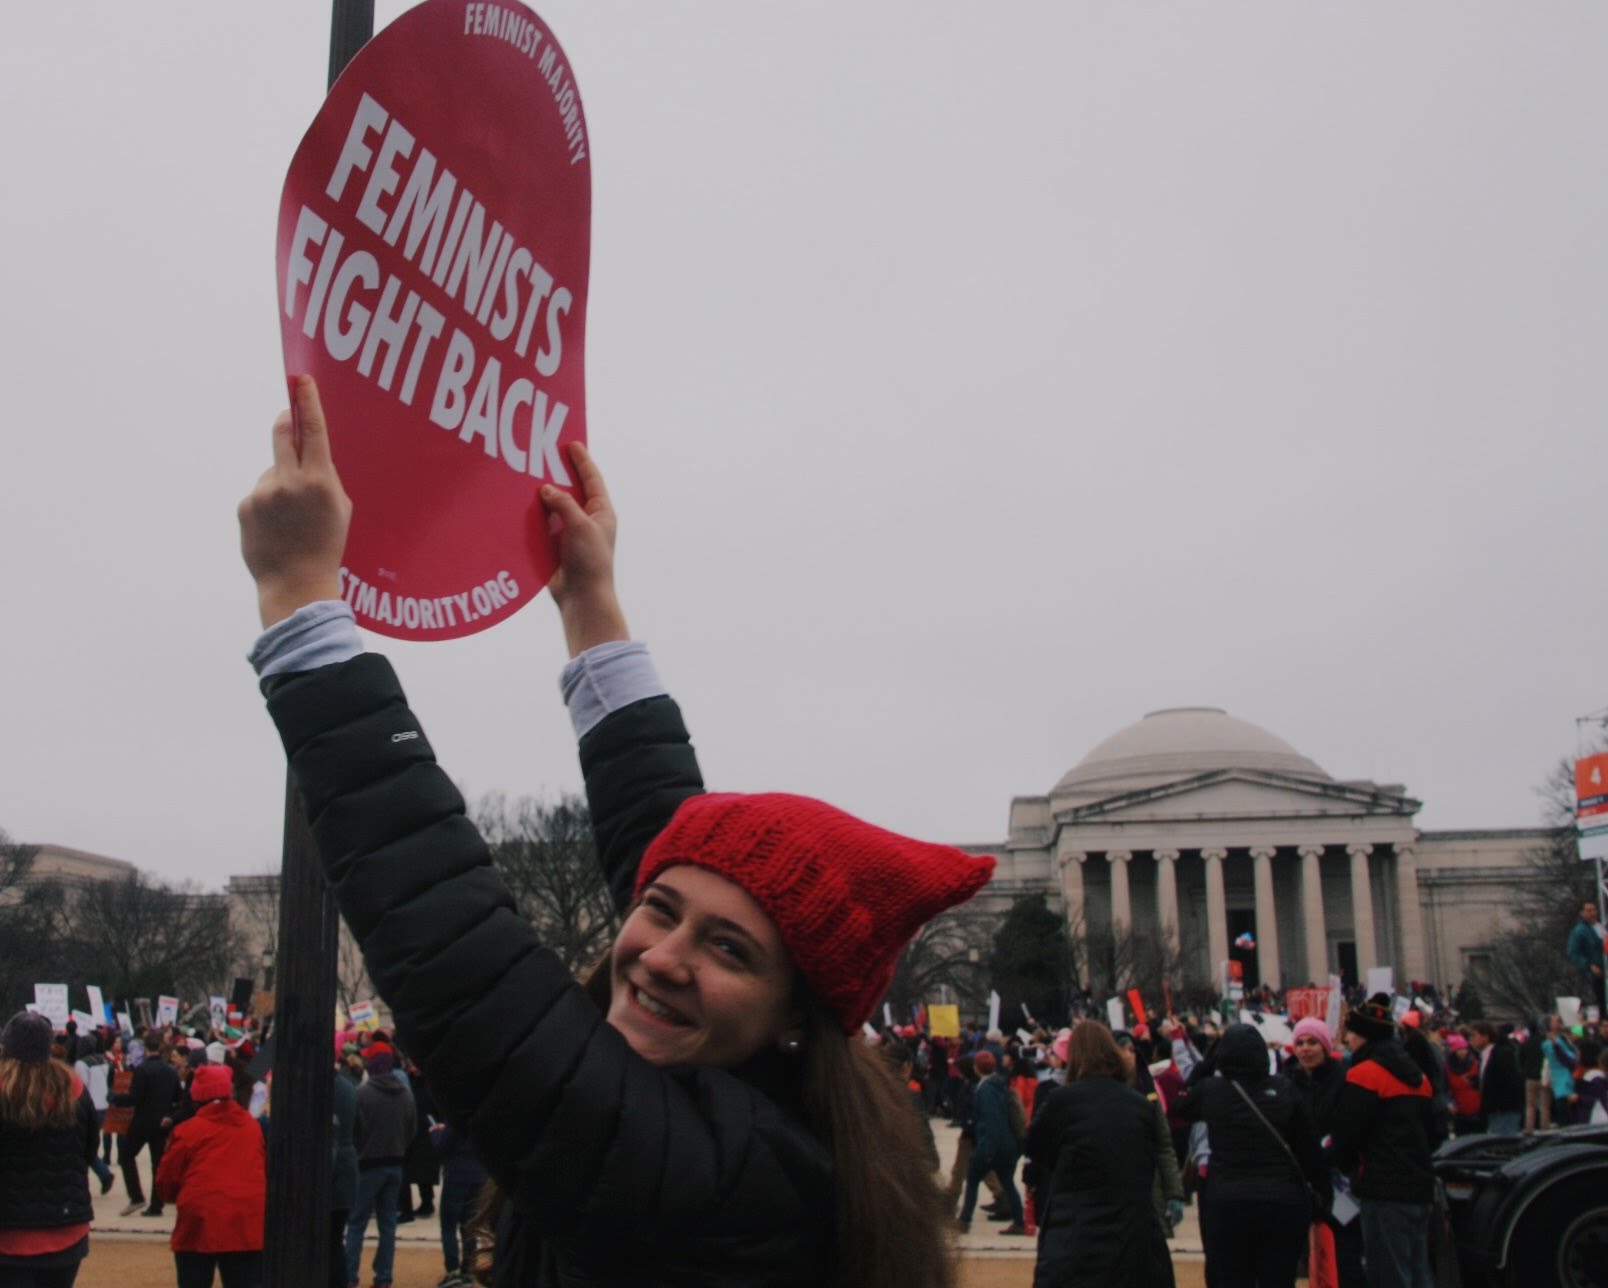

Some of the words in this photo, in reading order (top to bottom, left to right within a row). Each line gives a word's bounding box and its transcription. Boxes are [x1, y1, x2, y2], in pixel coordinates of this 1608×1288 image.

[464, 3, 543, 59] FEMINIST
[538, 44, 586, 165] MAJORITY
[325, 91, 572, 377] FEMINISTS
[284, 204, 446, 406] FIGHT
[429, 327, 573, 487] BACK
[1591, 767, 1602, 784] 4
